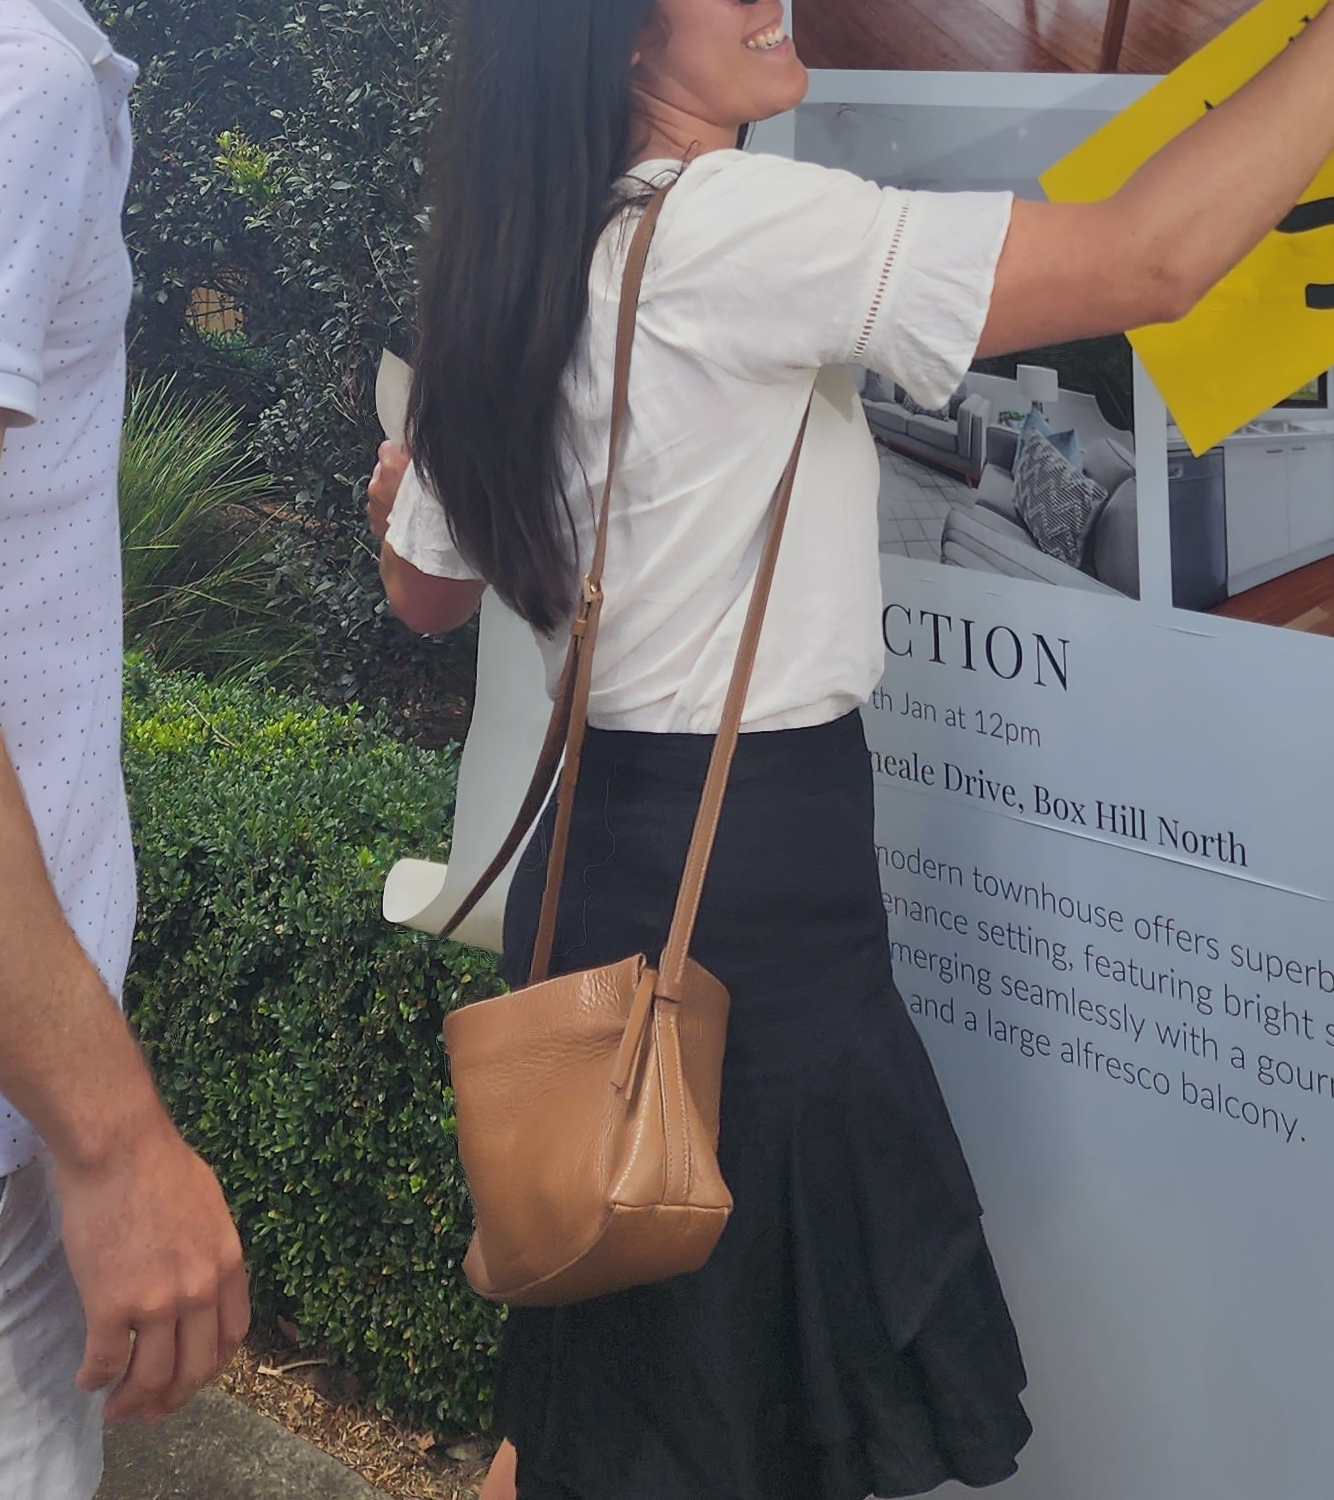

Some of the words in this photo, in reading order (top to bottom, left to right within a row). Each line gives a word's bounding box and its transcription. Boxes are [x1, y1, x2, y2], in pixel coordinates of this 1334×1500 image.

[900, 691, 937, 723] Jan
[945, 707, 967, 730] at
[974, 709, 1041, 748] 12pm
[942, 761, 1025, 815] Drive,
[1033, 783, 1087, 827] Box
[1095, 799, 1148, 843] Hill
[1156, 815, 1249, 868] North
[972, 865, 1124, 933] townhouse
[1134, 914, 1220, 961] offers
[977, 920, 1074, 972] setting,
[1083, 943, 1213, 1016] featuring
[1224, 982, 1315, 1041] bright
[1000, 974, 1146, 1044] seamlessly
[1154, 1021, 1220, 1063] with
[1230, 1046, 1246, 1071] a
[909, 993, 955, 1026] and
[964, 1011, 977, 1033] a
[987, 1008, 1051, 1058] large
[1060, 1036, 1170, 1096] alfresco
[1181, 1070, 1307, 1145] balcony.
